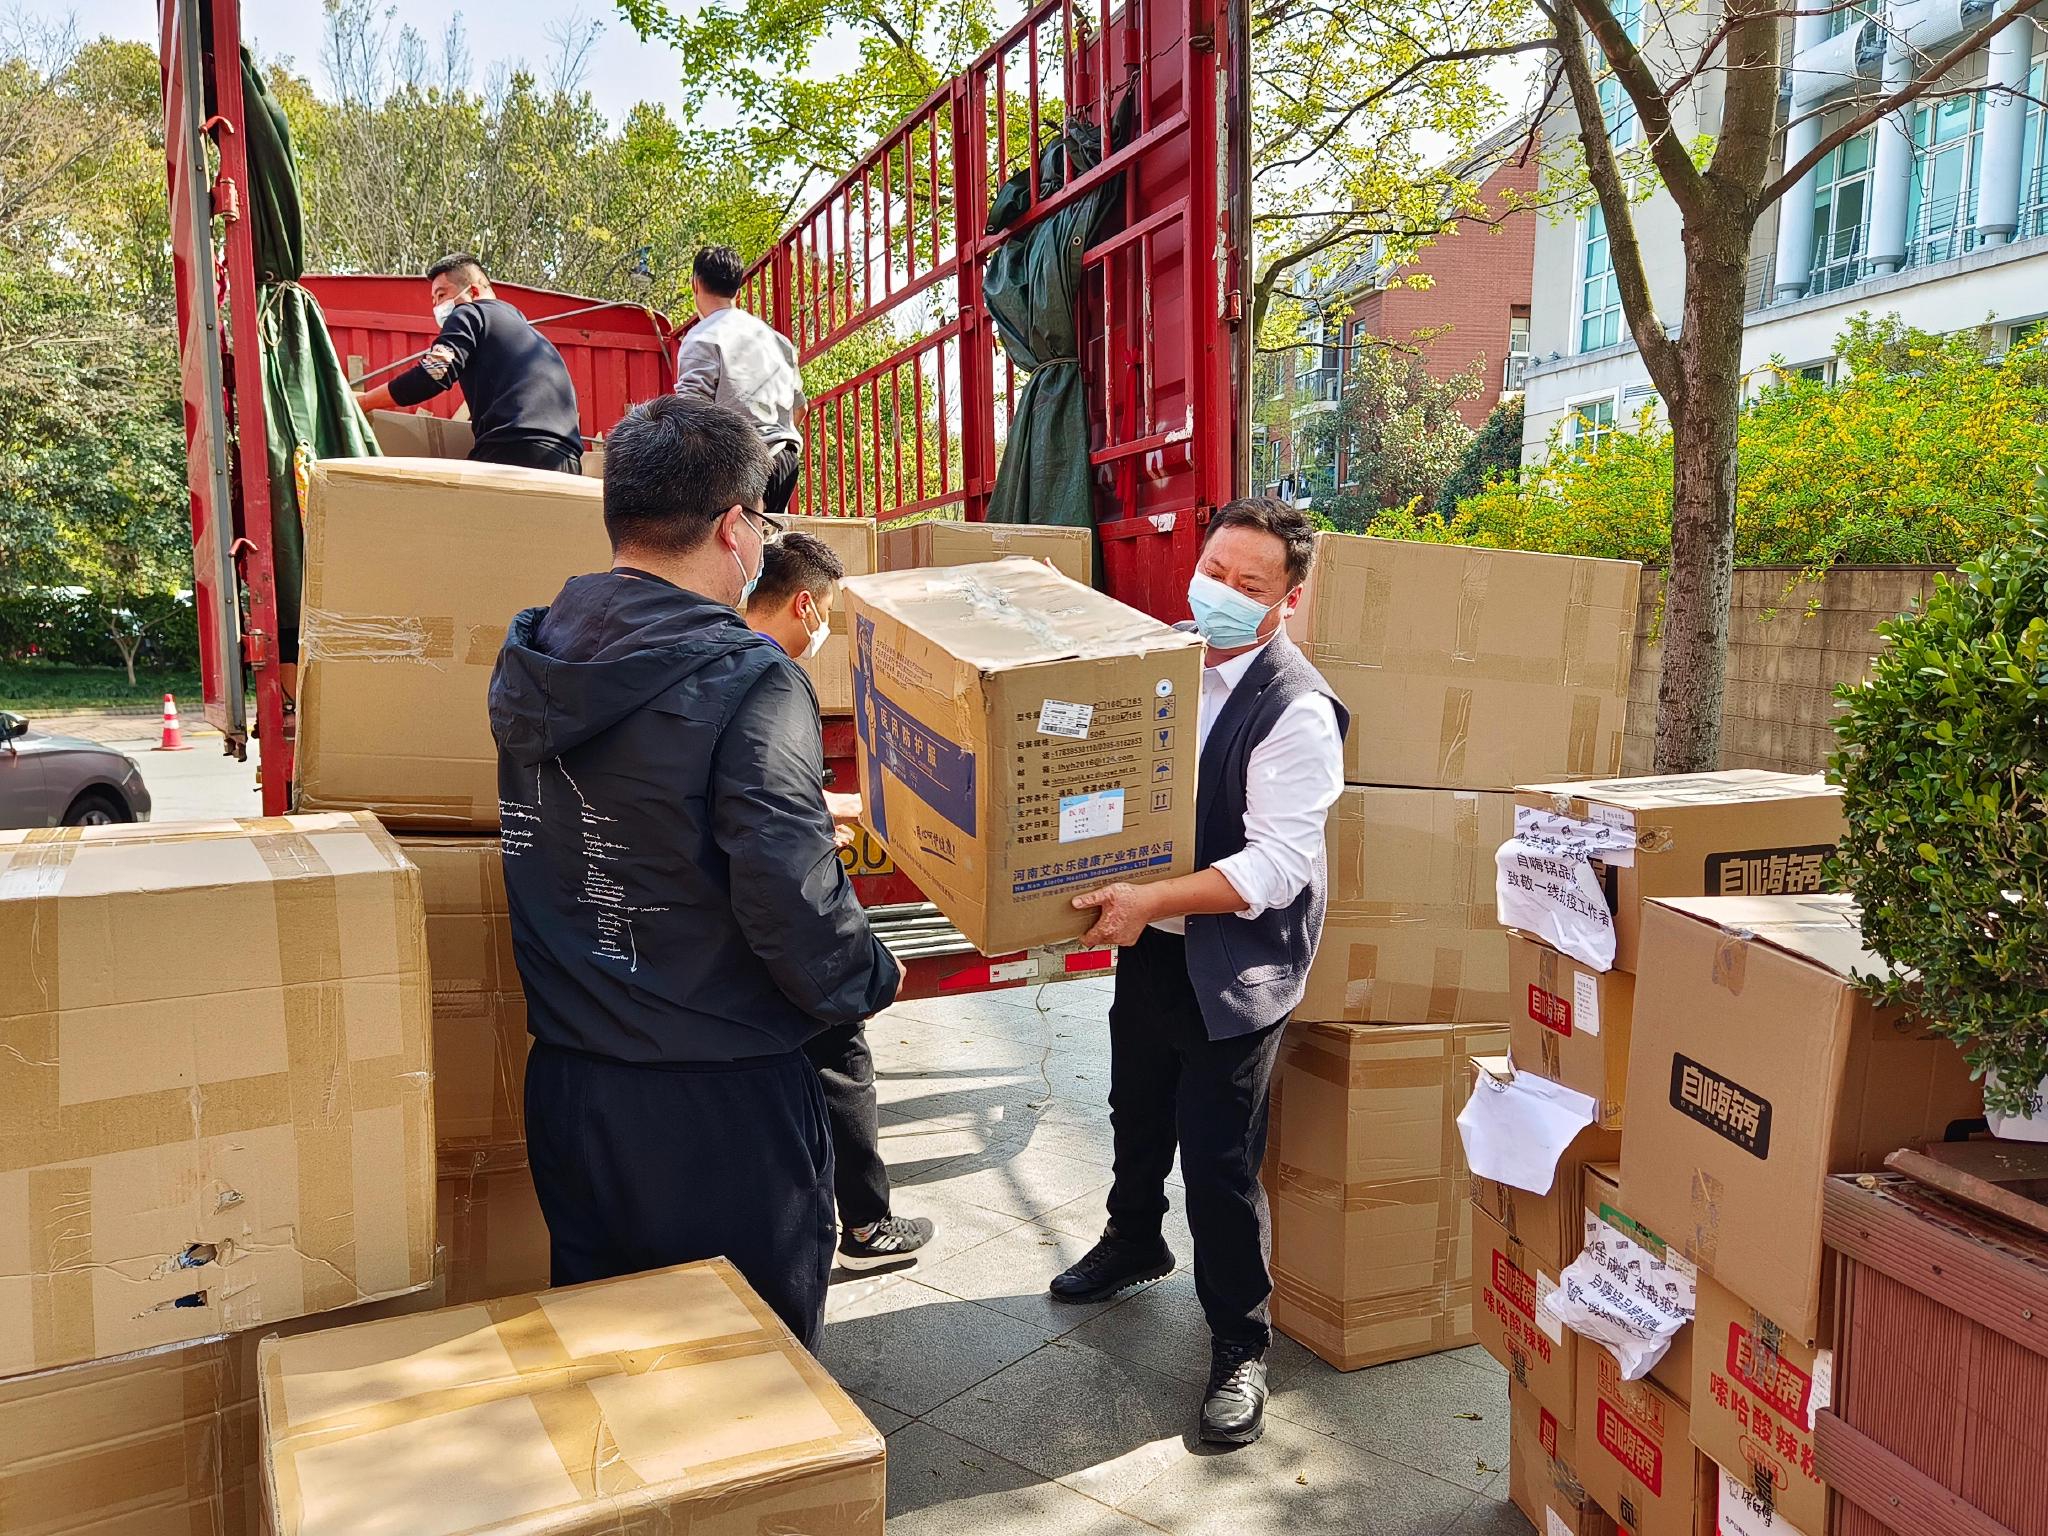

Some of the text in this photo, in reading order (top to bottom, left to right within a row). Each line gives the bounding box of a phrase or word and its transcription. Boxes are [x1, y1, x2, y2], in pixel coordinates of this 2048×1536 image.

[880, 707, 937, 768] 医用防护服
[1720, 853, 1823, 896] 自嗨锅
[1681, 1064, 1761, 1138] 自嗨锅
[1483, 1286, 1552, 1365] 嗦哈酸辣粉
[1603, 1410, 1656, 1479] 自嗨锅
